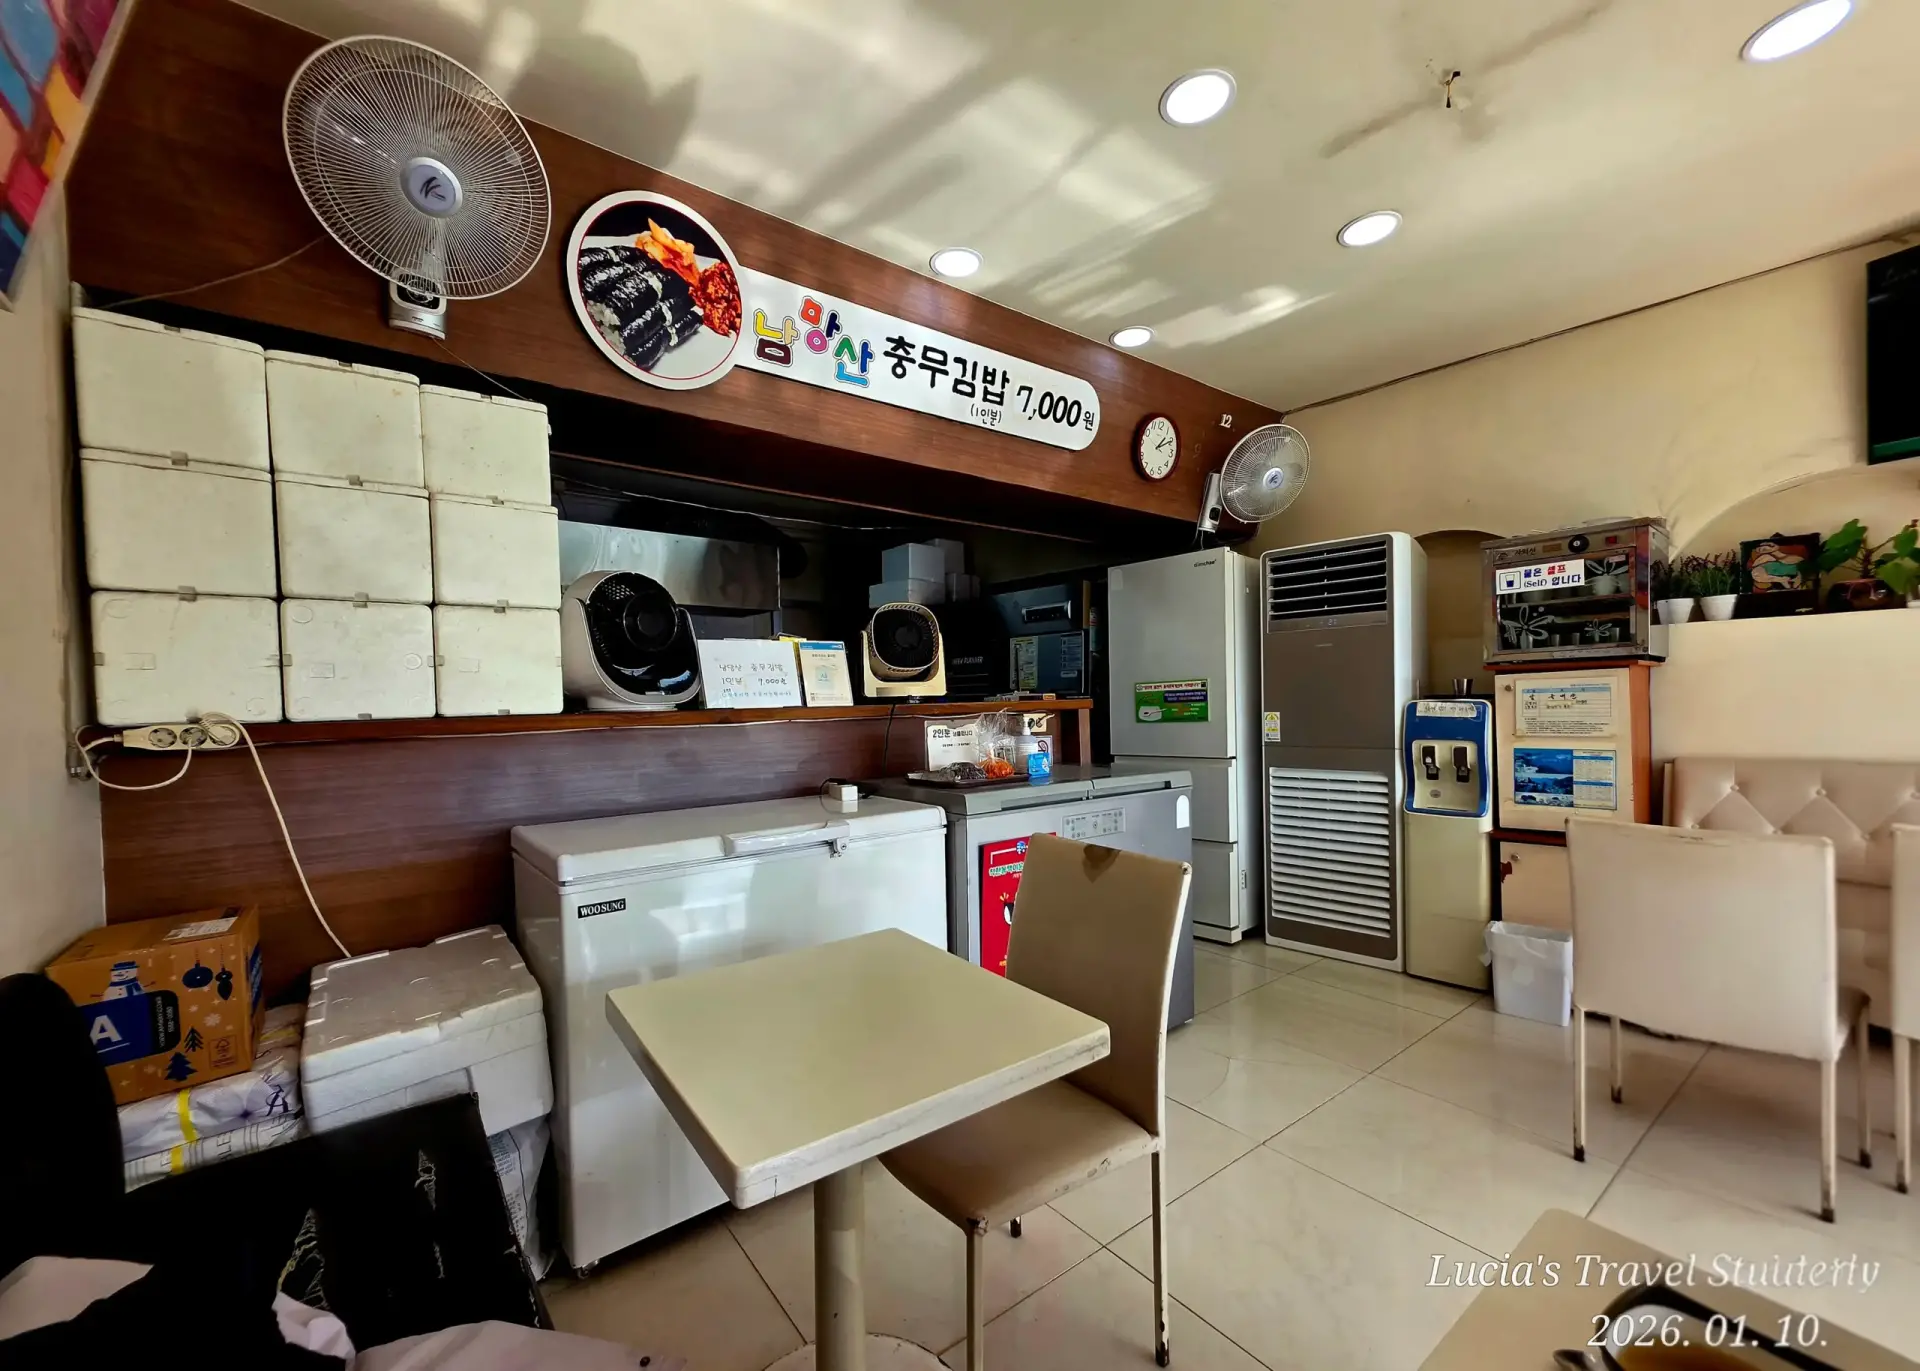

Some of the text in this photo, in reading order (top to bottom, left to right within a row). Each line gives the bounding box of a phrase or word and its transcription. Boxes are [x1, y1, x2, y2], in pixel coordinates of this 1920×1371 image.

[753, 295, 875, 388] 남망산
[883, 335, 1010, 406] 충무김밥
[970, 403, 1002, 427] (1인분)
[1219, 413, 1233, 429] 12
[1547, 564, 1567, 576] 셀프
[1523, 574, 1581, 588] (Self) 입니다
[580, 900, 625, 916] WOOSUNG
